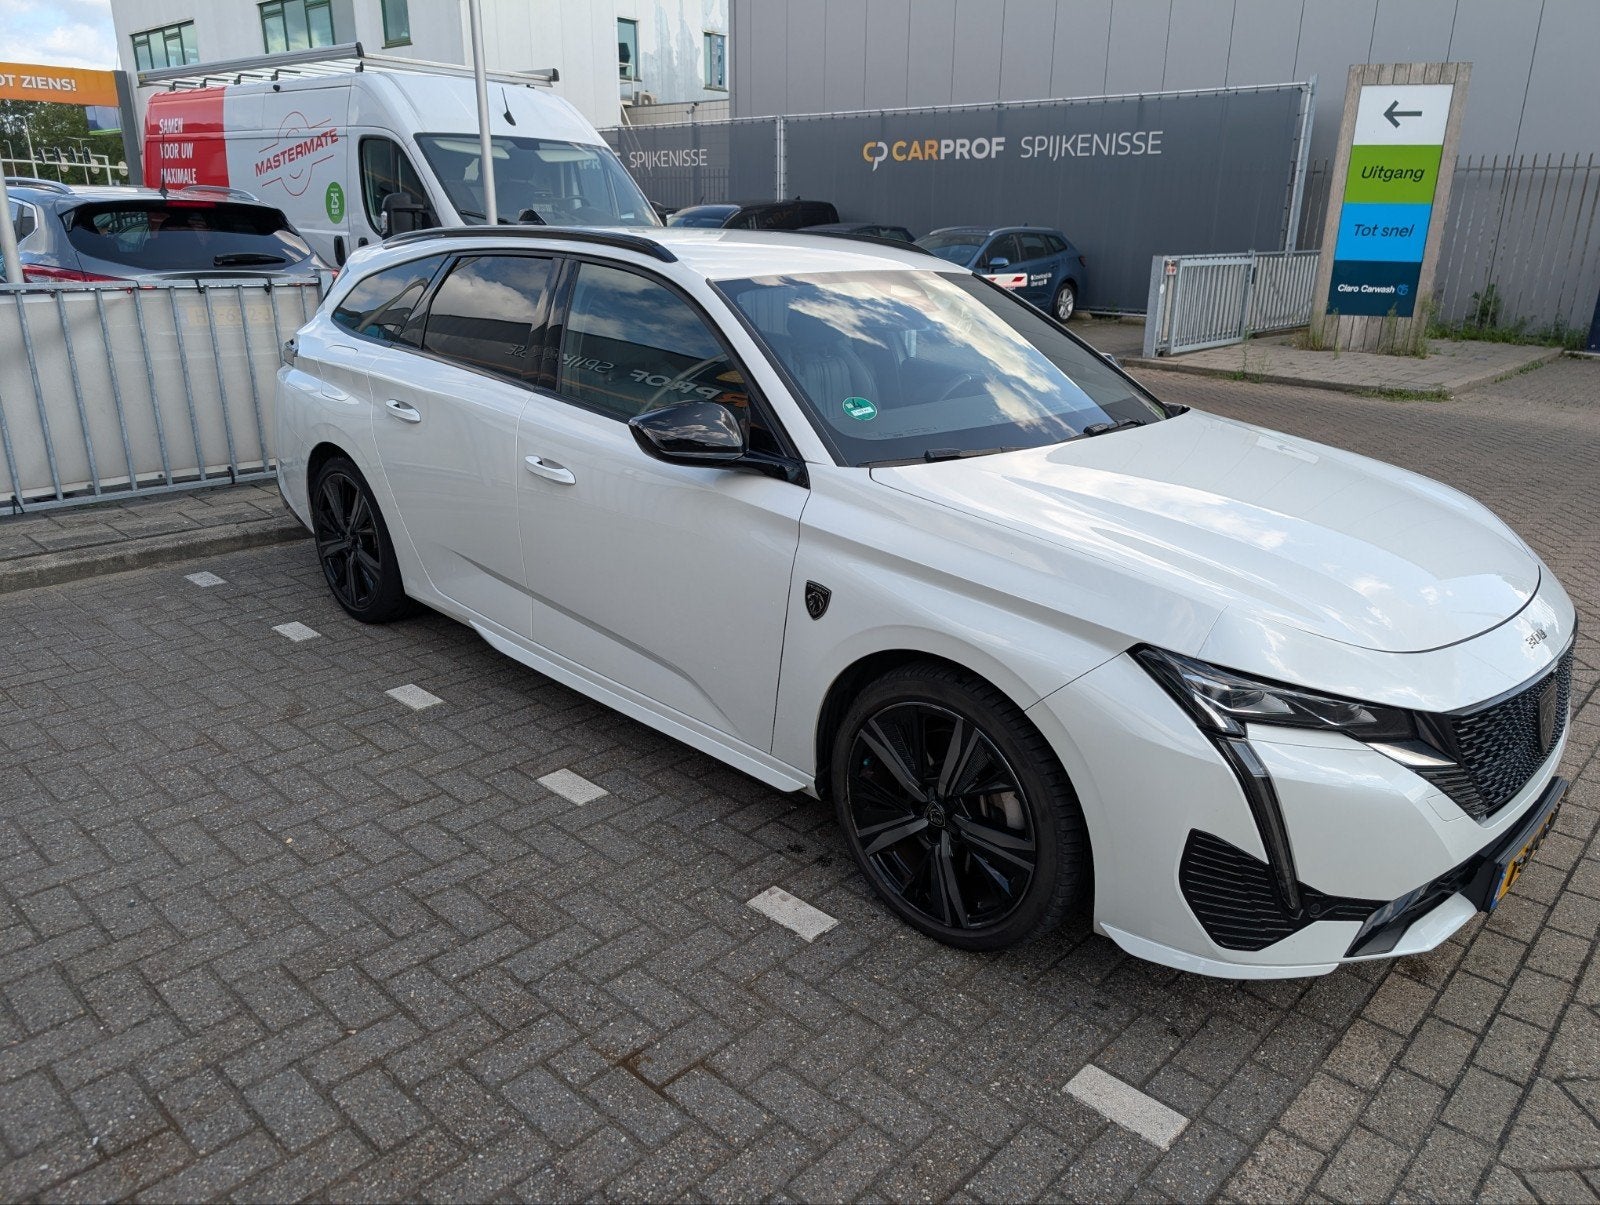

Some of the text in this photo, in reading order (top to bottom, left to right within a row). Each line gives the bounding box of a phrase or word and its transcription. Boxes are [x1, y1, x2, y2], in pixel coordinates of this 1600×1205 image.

[20, 75, 77, 92] ZIENS!
[159, 117, 183, 134] SAMEN
[181, 142, 194, 159] UW
[254, 128, 339, 177] MASTERMATE
[892, 137, 1006, 161] CARPROF
[1020, 131, 1164, 162] SPIJKENISSE
[629, 148, 708, 171] SPIJKENISSE
[161, 168, 197, 185] MAXIMALE
[1361, 165, 1425, 183] Uitgang
[1354, 223, 1415, 237] Tot snel
[1337, 284, 1395, 294] Claro Carwash
